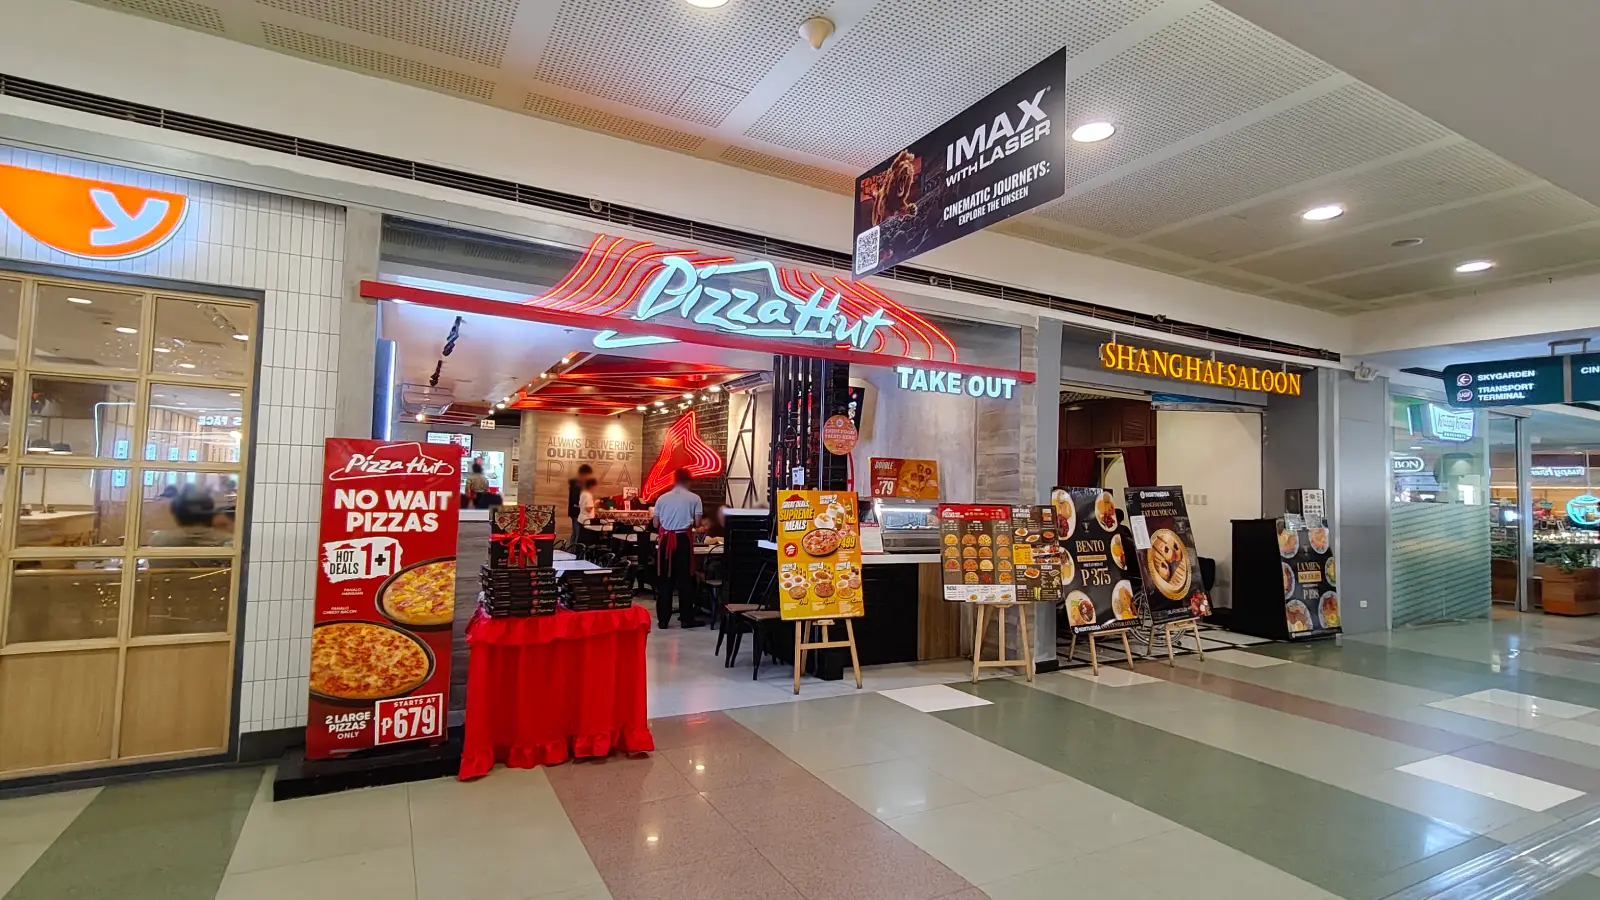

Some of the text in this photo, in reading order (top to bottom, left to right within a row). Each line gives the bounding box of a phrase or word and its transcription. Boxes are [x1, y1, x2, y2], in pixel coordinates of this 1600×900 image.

[945, 119, 1050, 188] WITH LASER
[943, 161, 1050, 221] CINEMATIC JOURNEYS:
[958, 186, 1028, 226] EXPLORE THE UNSEEN
[634, 256, 895, 350] Pizza Hut
[896, 366, 1017, 399] TAKE OUT
[1477, 370, 1535, 382] SKYGARDEN
[1478, 383, 1534, 394] TRANSPORT
[1478, 391, 1526, 402] TERMINAL
[547, 436, 635, 451] ALWAYS DELIVERING
[546, 448, 634, 461] OUR LOVE OF
[344, 453, 449, 475] Pizza Hut
[547, 459, 633, 487] PZA
[334, 488, 452, 511] NO WAIT
[346, 512, 439, 533] PIZZAS
[1075, 540, 1105, 553] BENTO
[335, 550, 355, 563] HOT
[329, 562, 359, 575] DEALS
[1090, 566, 1111, 586] 375
[393, 697, 437, 708] STARTS AT
[325, 711, 371, 725] 2 LARGE
[328, 720, 367, 733] PIZZAS
[337, 731, 360, 740] ONLY
